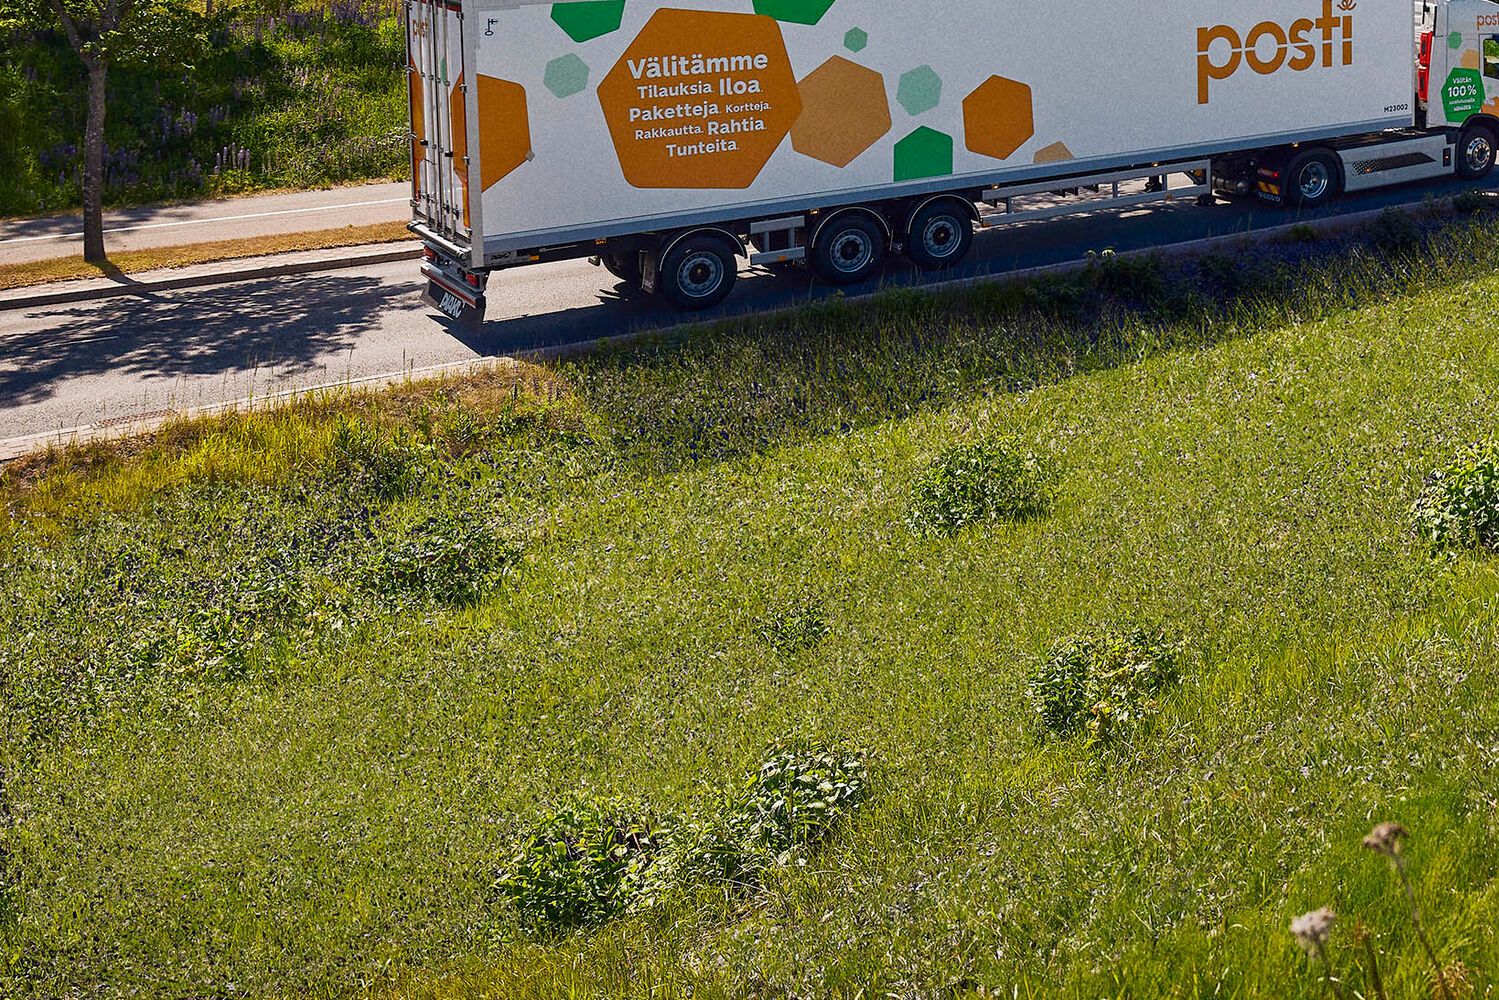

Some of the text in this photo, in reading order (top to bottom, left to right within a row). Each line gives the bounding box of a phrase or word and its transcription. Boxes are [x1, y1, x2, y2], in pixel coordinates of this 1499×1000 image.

[627, 53, 768, 79] Välitämme
[637, 78, 764, 99] Tilauksia. Iloa.
[629, 101, 772, 122] Paketteja. Kortteja.
[1383, 104, 1408, 112] M23002
[635, 117, 767, 140] Rakkautta. Rahtia.
[666, 139, 740, 157] Tunteita.
